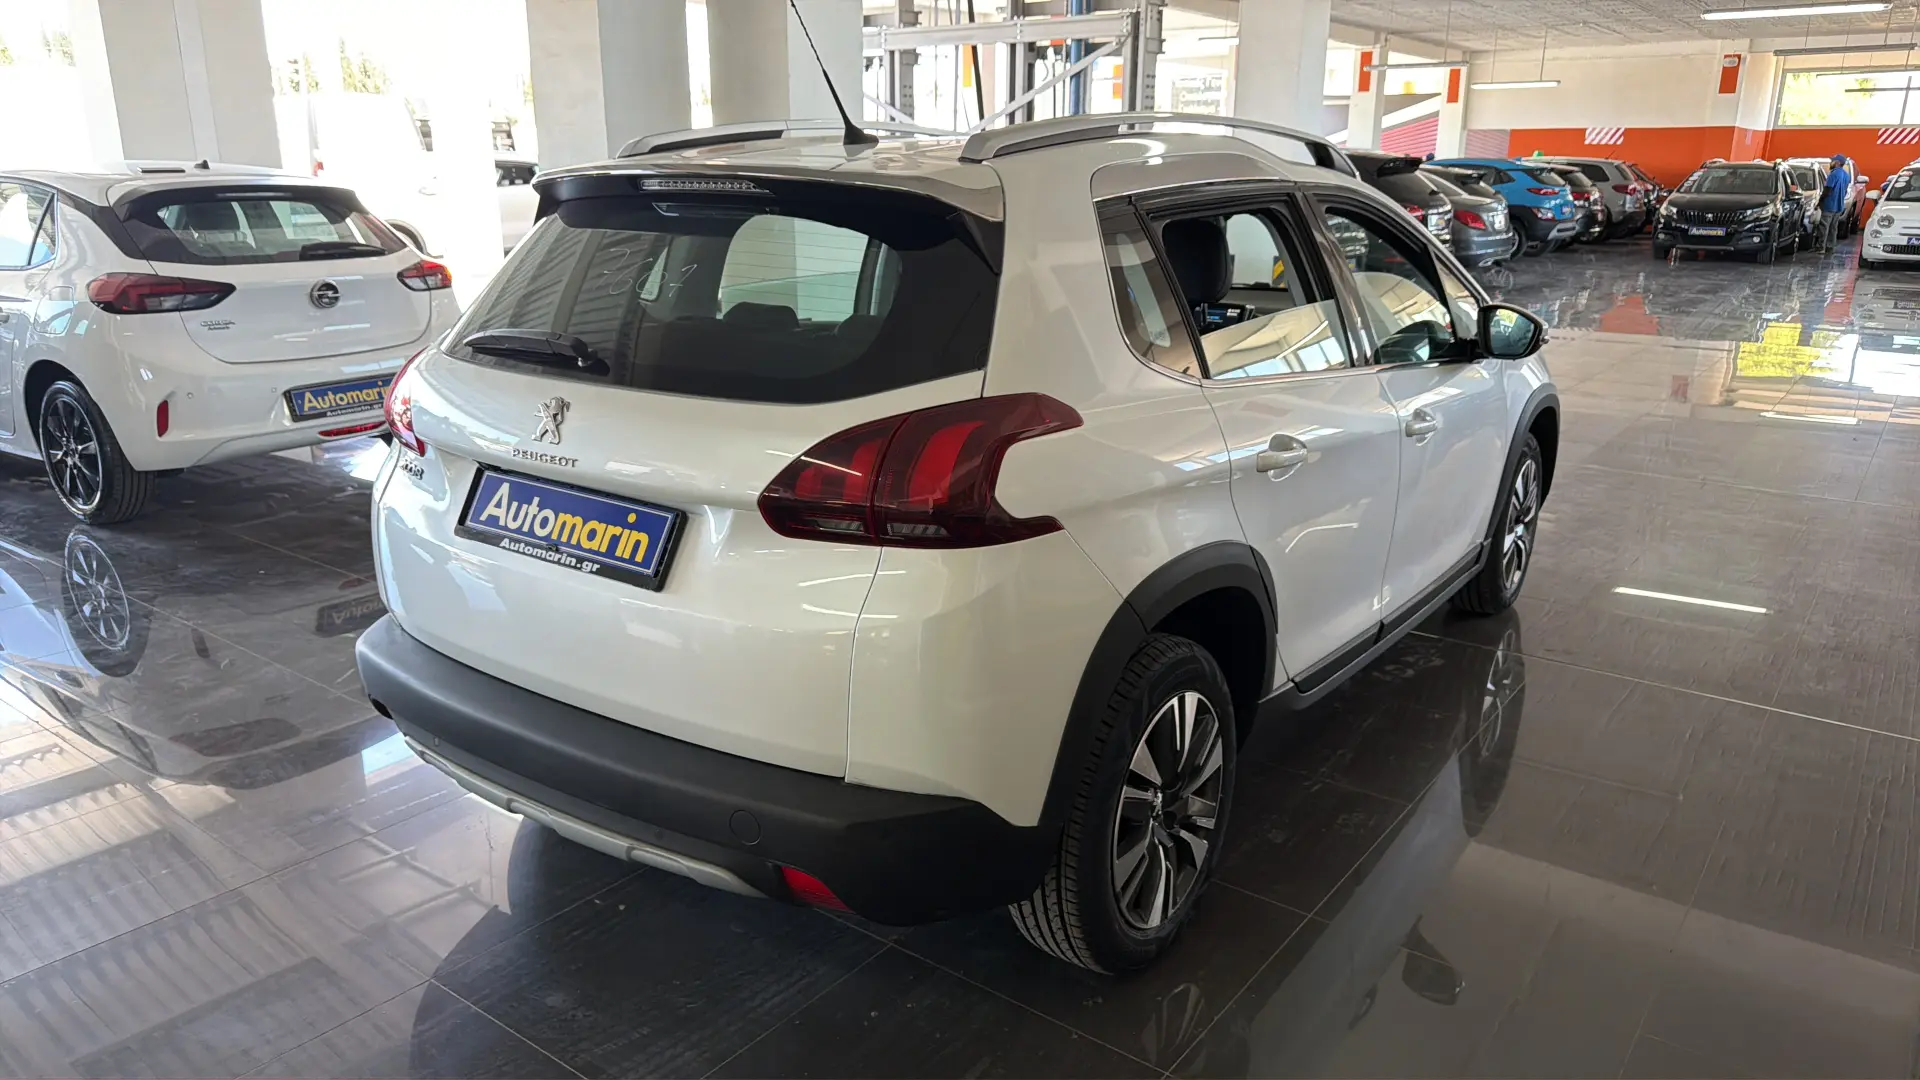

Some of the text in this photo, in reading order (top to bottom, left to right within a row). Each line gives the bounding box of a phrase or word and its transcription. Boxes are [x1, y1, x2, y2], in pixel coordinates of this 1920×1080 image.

[512, 448, 578, 468] PEUGEOT
[479, 481, 650, 563] Automarin
[499, 537, 601, 573] Automarin.gr
